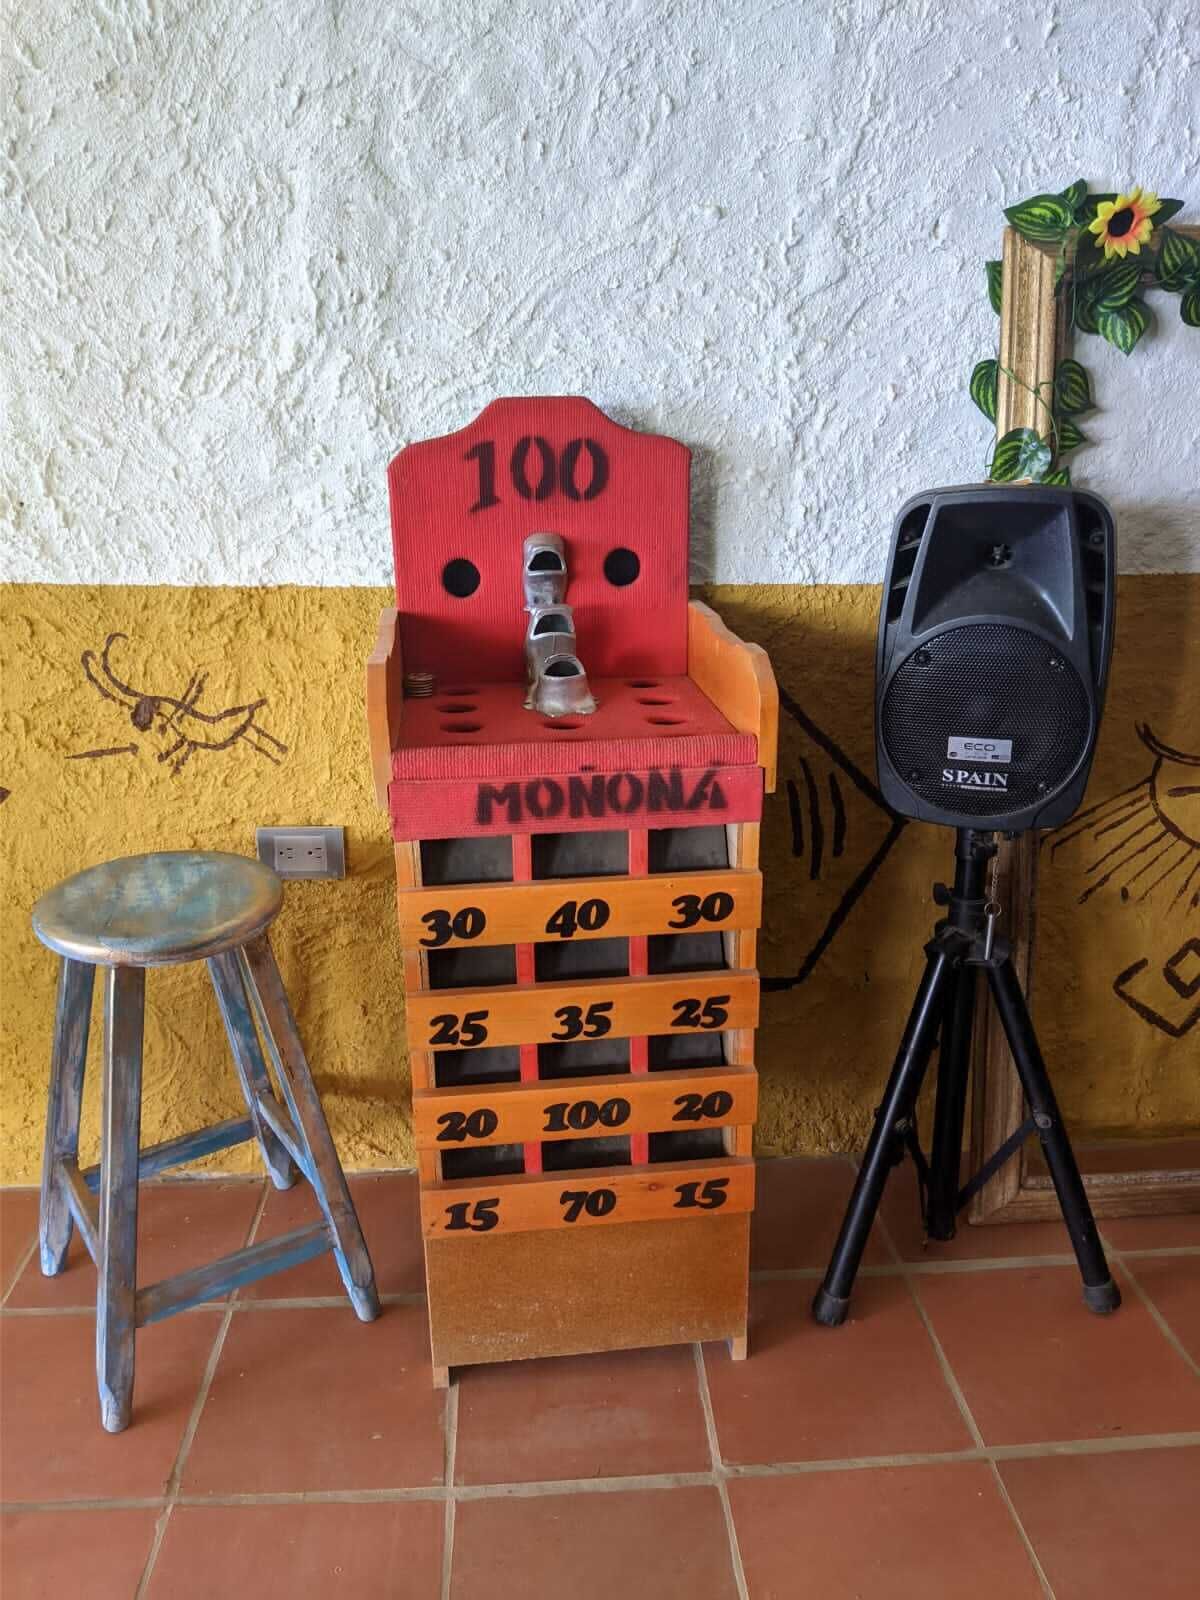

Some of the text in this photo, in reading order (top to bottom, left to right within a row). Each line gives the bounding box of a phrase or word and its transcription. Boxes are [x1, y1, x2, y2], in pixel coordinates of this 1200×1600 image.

[464, 436, 609, 513] 100
[963, 742, 996, 752] ECO
[942, 768, 1008, 787] SPAIN
[419, 891, 735, 947] 30 40 30
[428, 995, 731, 1047] 25 35 25
[436, 1090, 734, 1142] 20 100 20
[444, 1177, 730, 1232] 15 70 15
